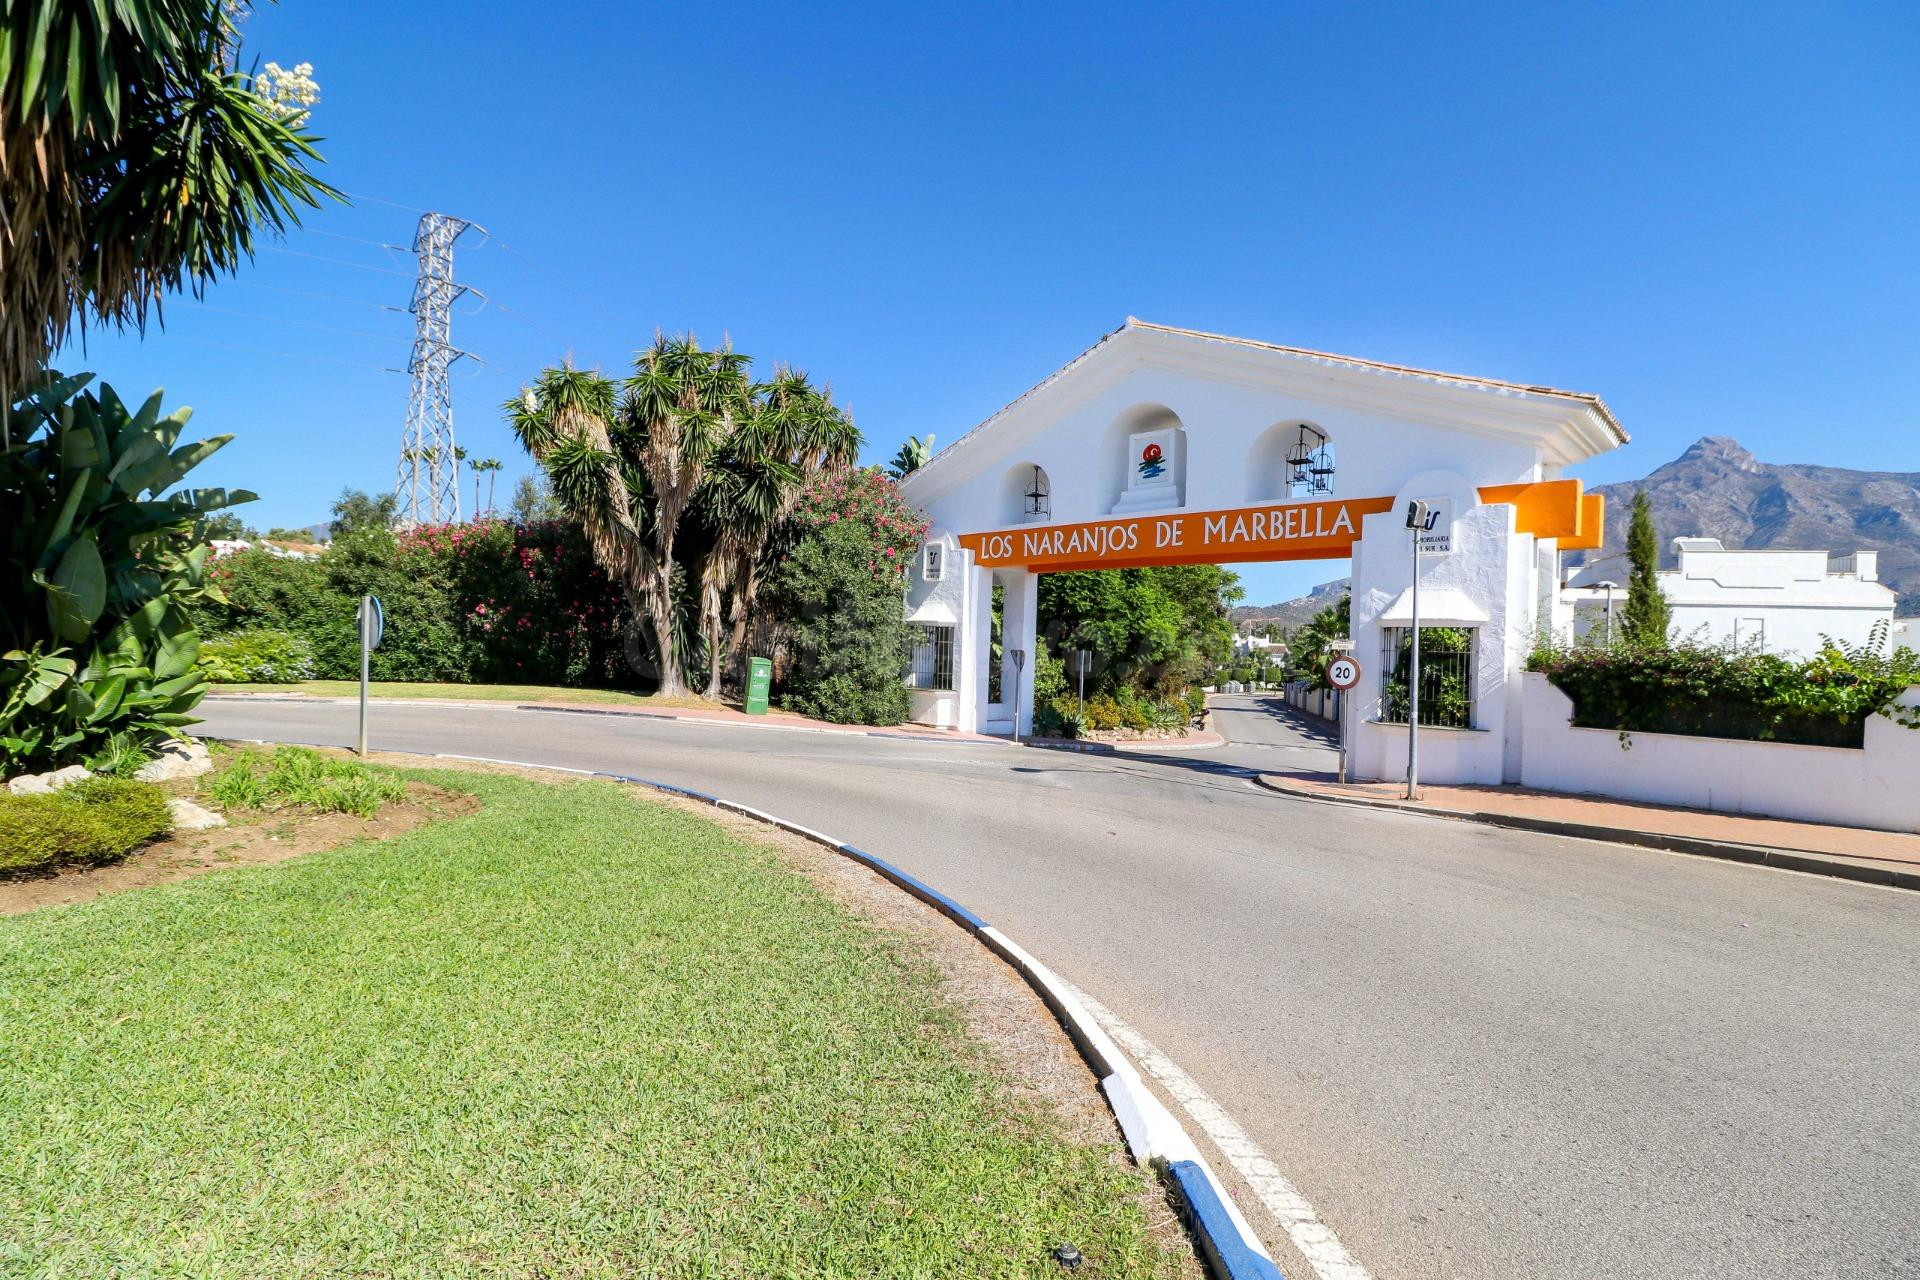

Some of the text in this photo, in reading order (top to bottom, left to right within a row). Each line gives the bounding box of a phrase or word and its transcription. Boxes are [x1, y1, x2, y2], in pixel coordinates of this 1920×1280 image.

[981, 504, 1356, 559] LOS NARANJOS DE MARBELLA
[1335, 666, 1350, 679] 20
